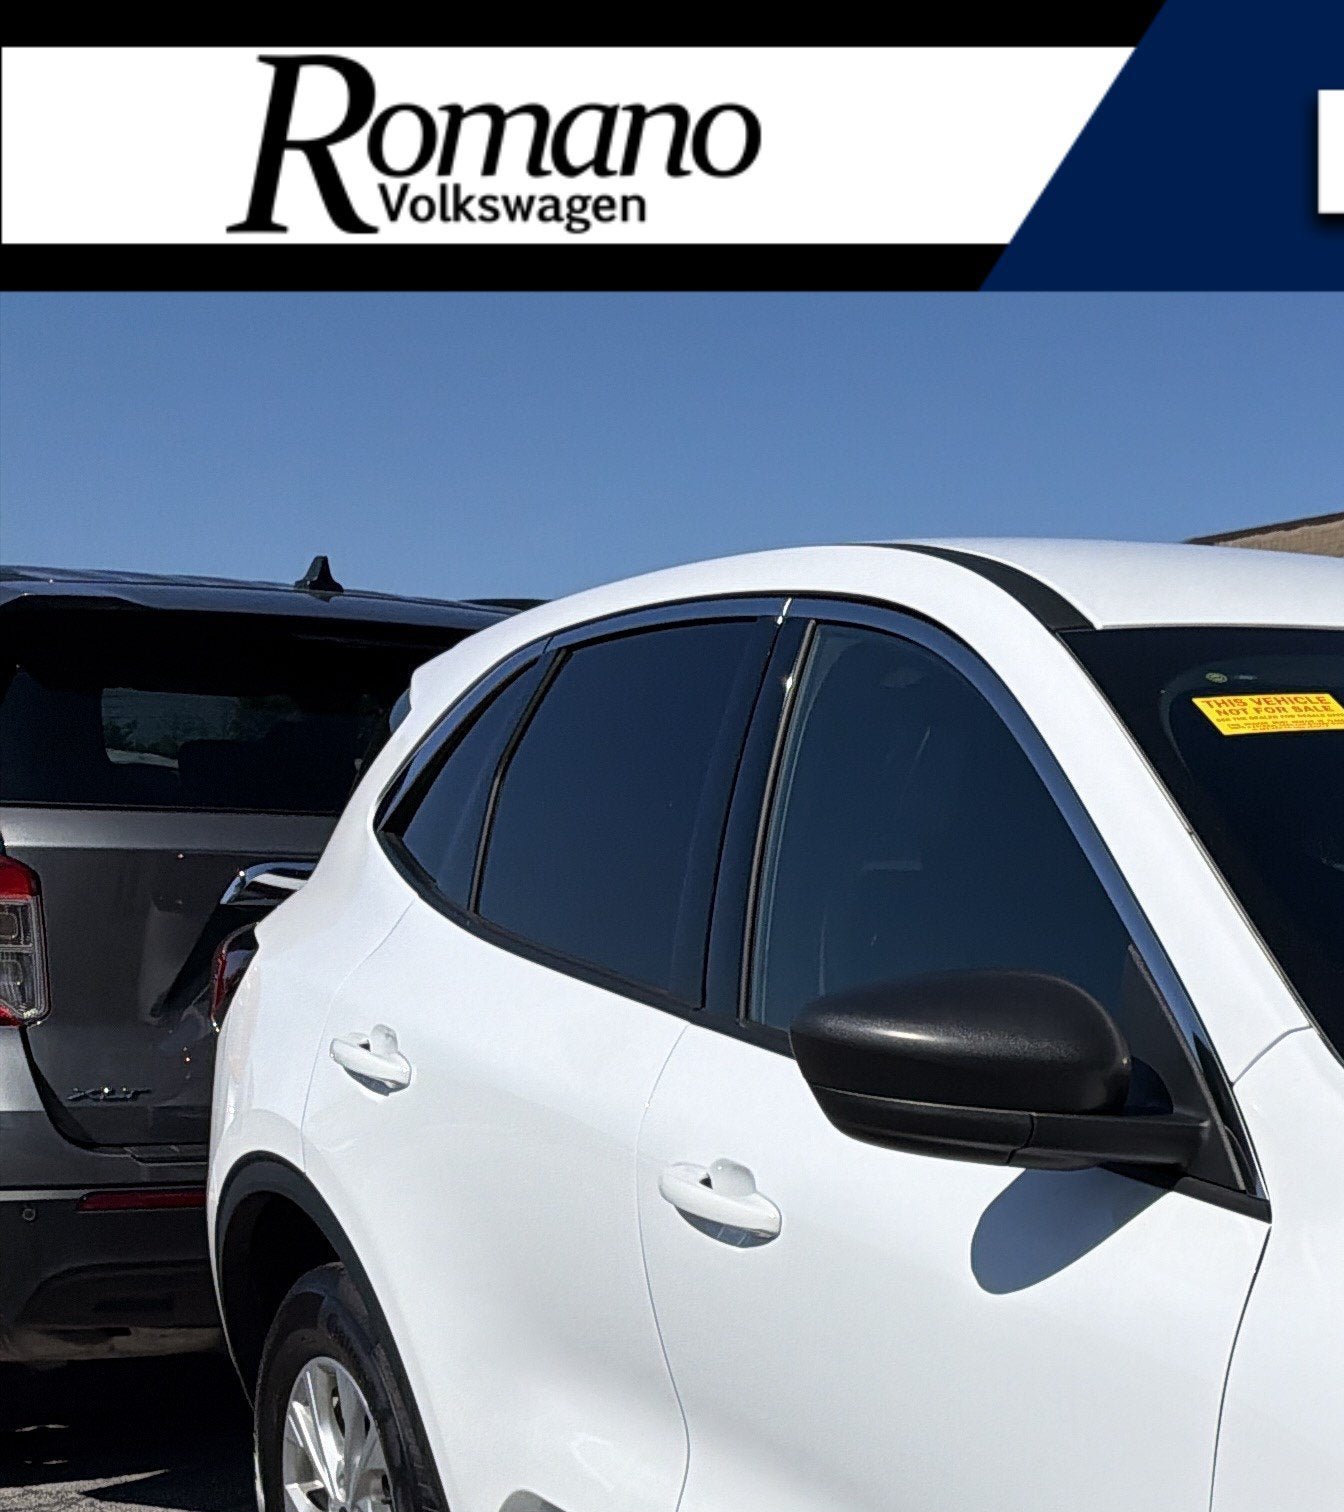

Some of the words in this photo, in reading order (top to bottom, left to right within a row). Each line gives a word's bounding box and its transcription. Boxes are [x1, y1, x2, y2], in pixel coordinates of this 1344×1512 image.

[1202, 697, 1248, 709] THIS
[1249, 695, 1332, 707] VEHICLE
[1215, 706, 1250, 717] NOT
[1252, 705, 1289, 715] FOR
[1291, 704, 1336, 714] SALE
